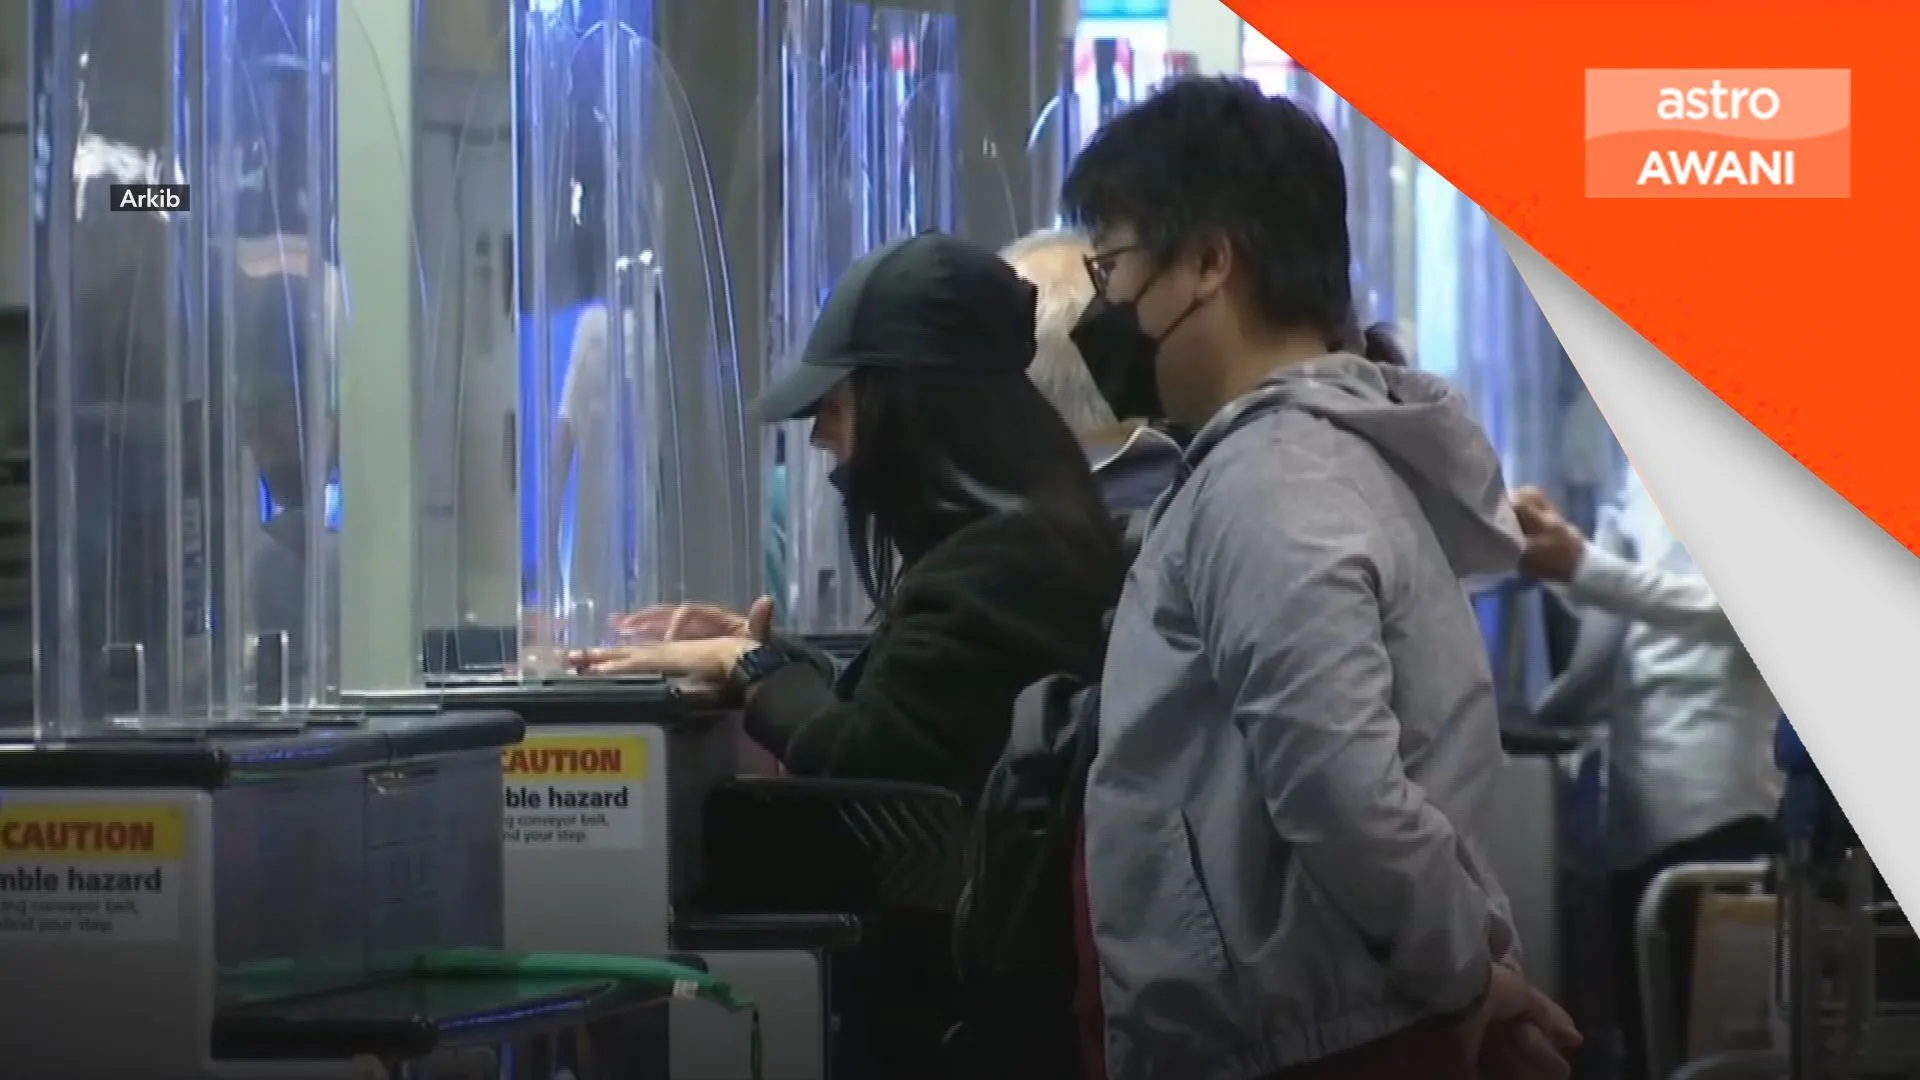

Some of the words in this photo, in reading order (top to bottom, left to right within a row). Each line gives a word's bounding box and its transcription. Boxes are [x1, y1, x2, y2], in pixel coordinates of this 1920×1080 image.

[548, 786, 629, 808] hazard
[1, 820, 155, 851] CAUTION
[67, 866, 163, 892] hazard
